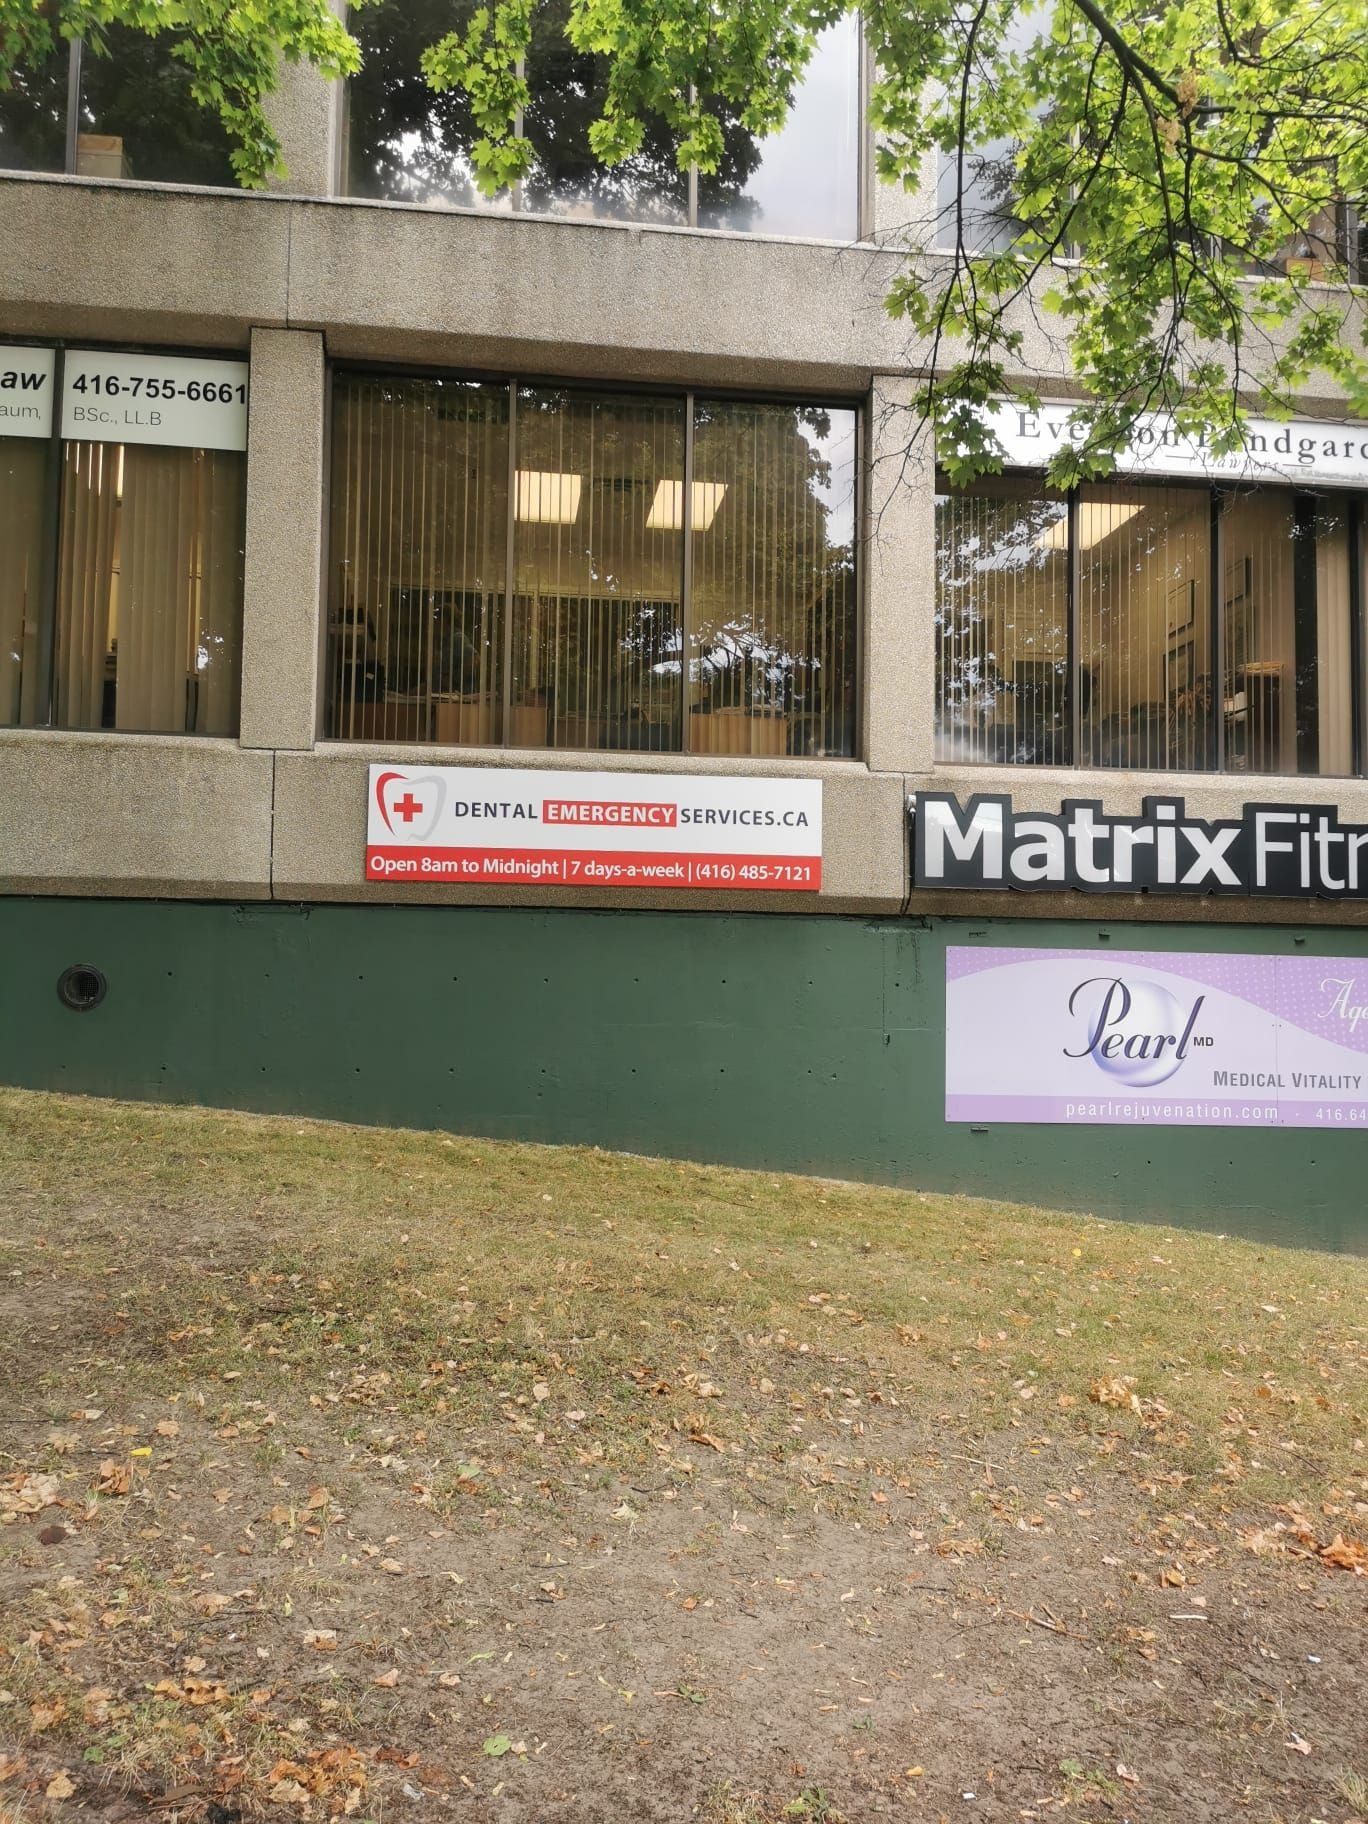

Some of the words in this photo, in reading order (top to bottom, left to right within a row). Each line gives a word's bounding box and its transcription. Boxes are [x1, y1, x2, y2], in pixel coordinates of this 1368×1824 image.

[0, 371, 47, 391] aw
[72, 373, 246, 404] 416-755-6661
[124, 409, 162, 426] LL.B
[1016, 411, 1180, 448] Eveon
[455, 801, 538, 819] DENTAL
[547, 804, 674, 824] EMERGENCY
[680, 808, 809, 827] SERVICES.CA
[924, 800, 1242, 885] Matrix
[370, 855, 417, 875] Open
[421, 857, 458, 873] 8am
[462, 859, 479, 873] to
[483, 857, 558, 878] Midnight
[571, 861, 581, 875] 7
[584, 860, 684, 880] days-a-week
[696, 863, 735, 881] (416)
[739, 865, 811, 881] 485-7121
[1062, 976, 1205, 1060] Pearl
[1193, 1036, 1214, 1047] MD
[1213, 1070, 1286, 1088] MEDICAL
[1291, 1072, 1362, 1090] VITALITY
[1066, 1101, 1279, 1120] pearlrejuvenation.com
